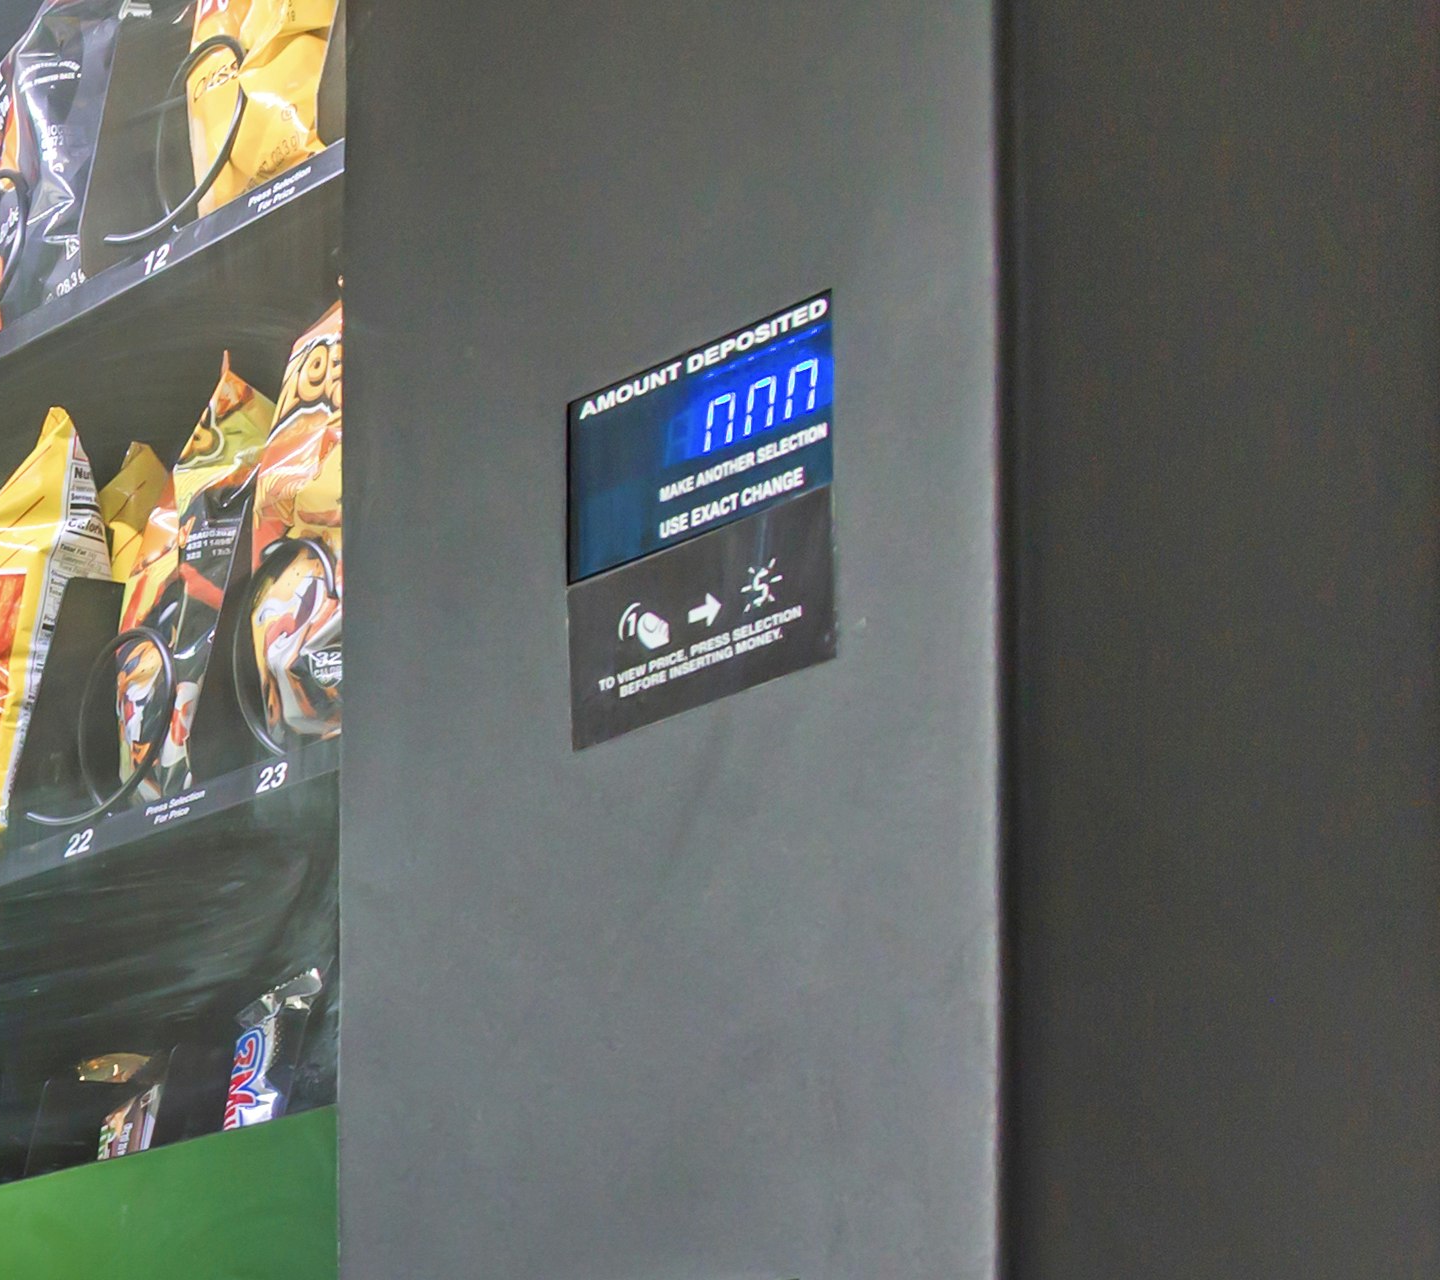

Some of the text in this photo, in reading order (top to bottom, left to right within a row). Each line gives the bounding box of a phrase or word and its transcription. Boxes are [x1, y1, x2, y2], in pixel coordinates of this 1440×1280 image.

[142, 247, 169, 275] 12
[580, 299, 828, 419] AMOUNT DEPOSITED
[659, 423, 828, 502] MAKE ANOTHER SELECTION
[659, 467, 803, 539] USE EXACT CHANGE
[599, 676, 615, 691] TO
[617, 665, 645, 685] VIEW
[690, 636, 730, 662] PRESS
[732, 605, 801, 642] SELECTION
[619, 671, 666, 698] BEFORE
[669, 647, 733, 680] INSERTING
[255, 763, 288, 794] 23
[65, 830, 93, 857] 22
